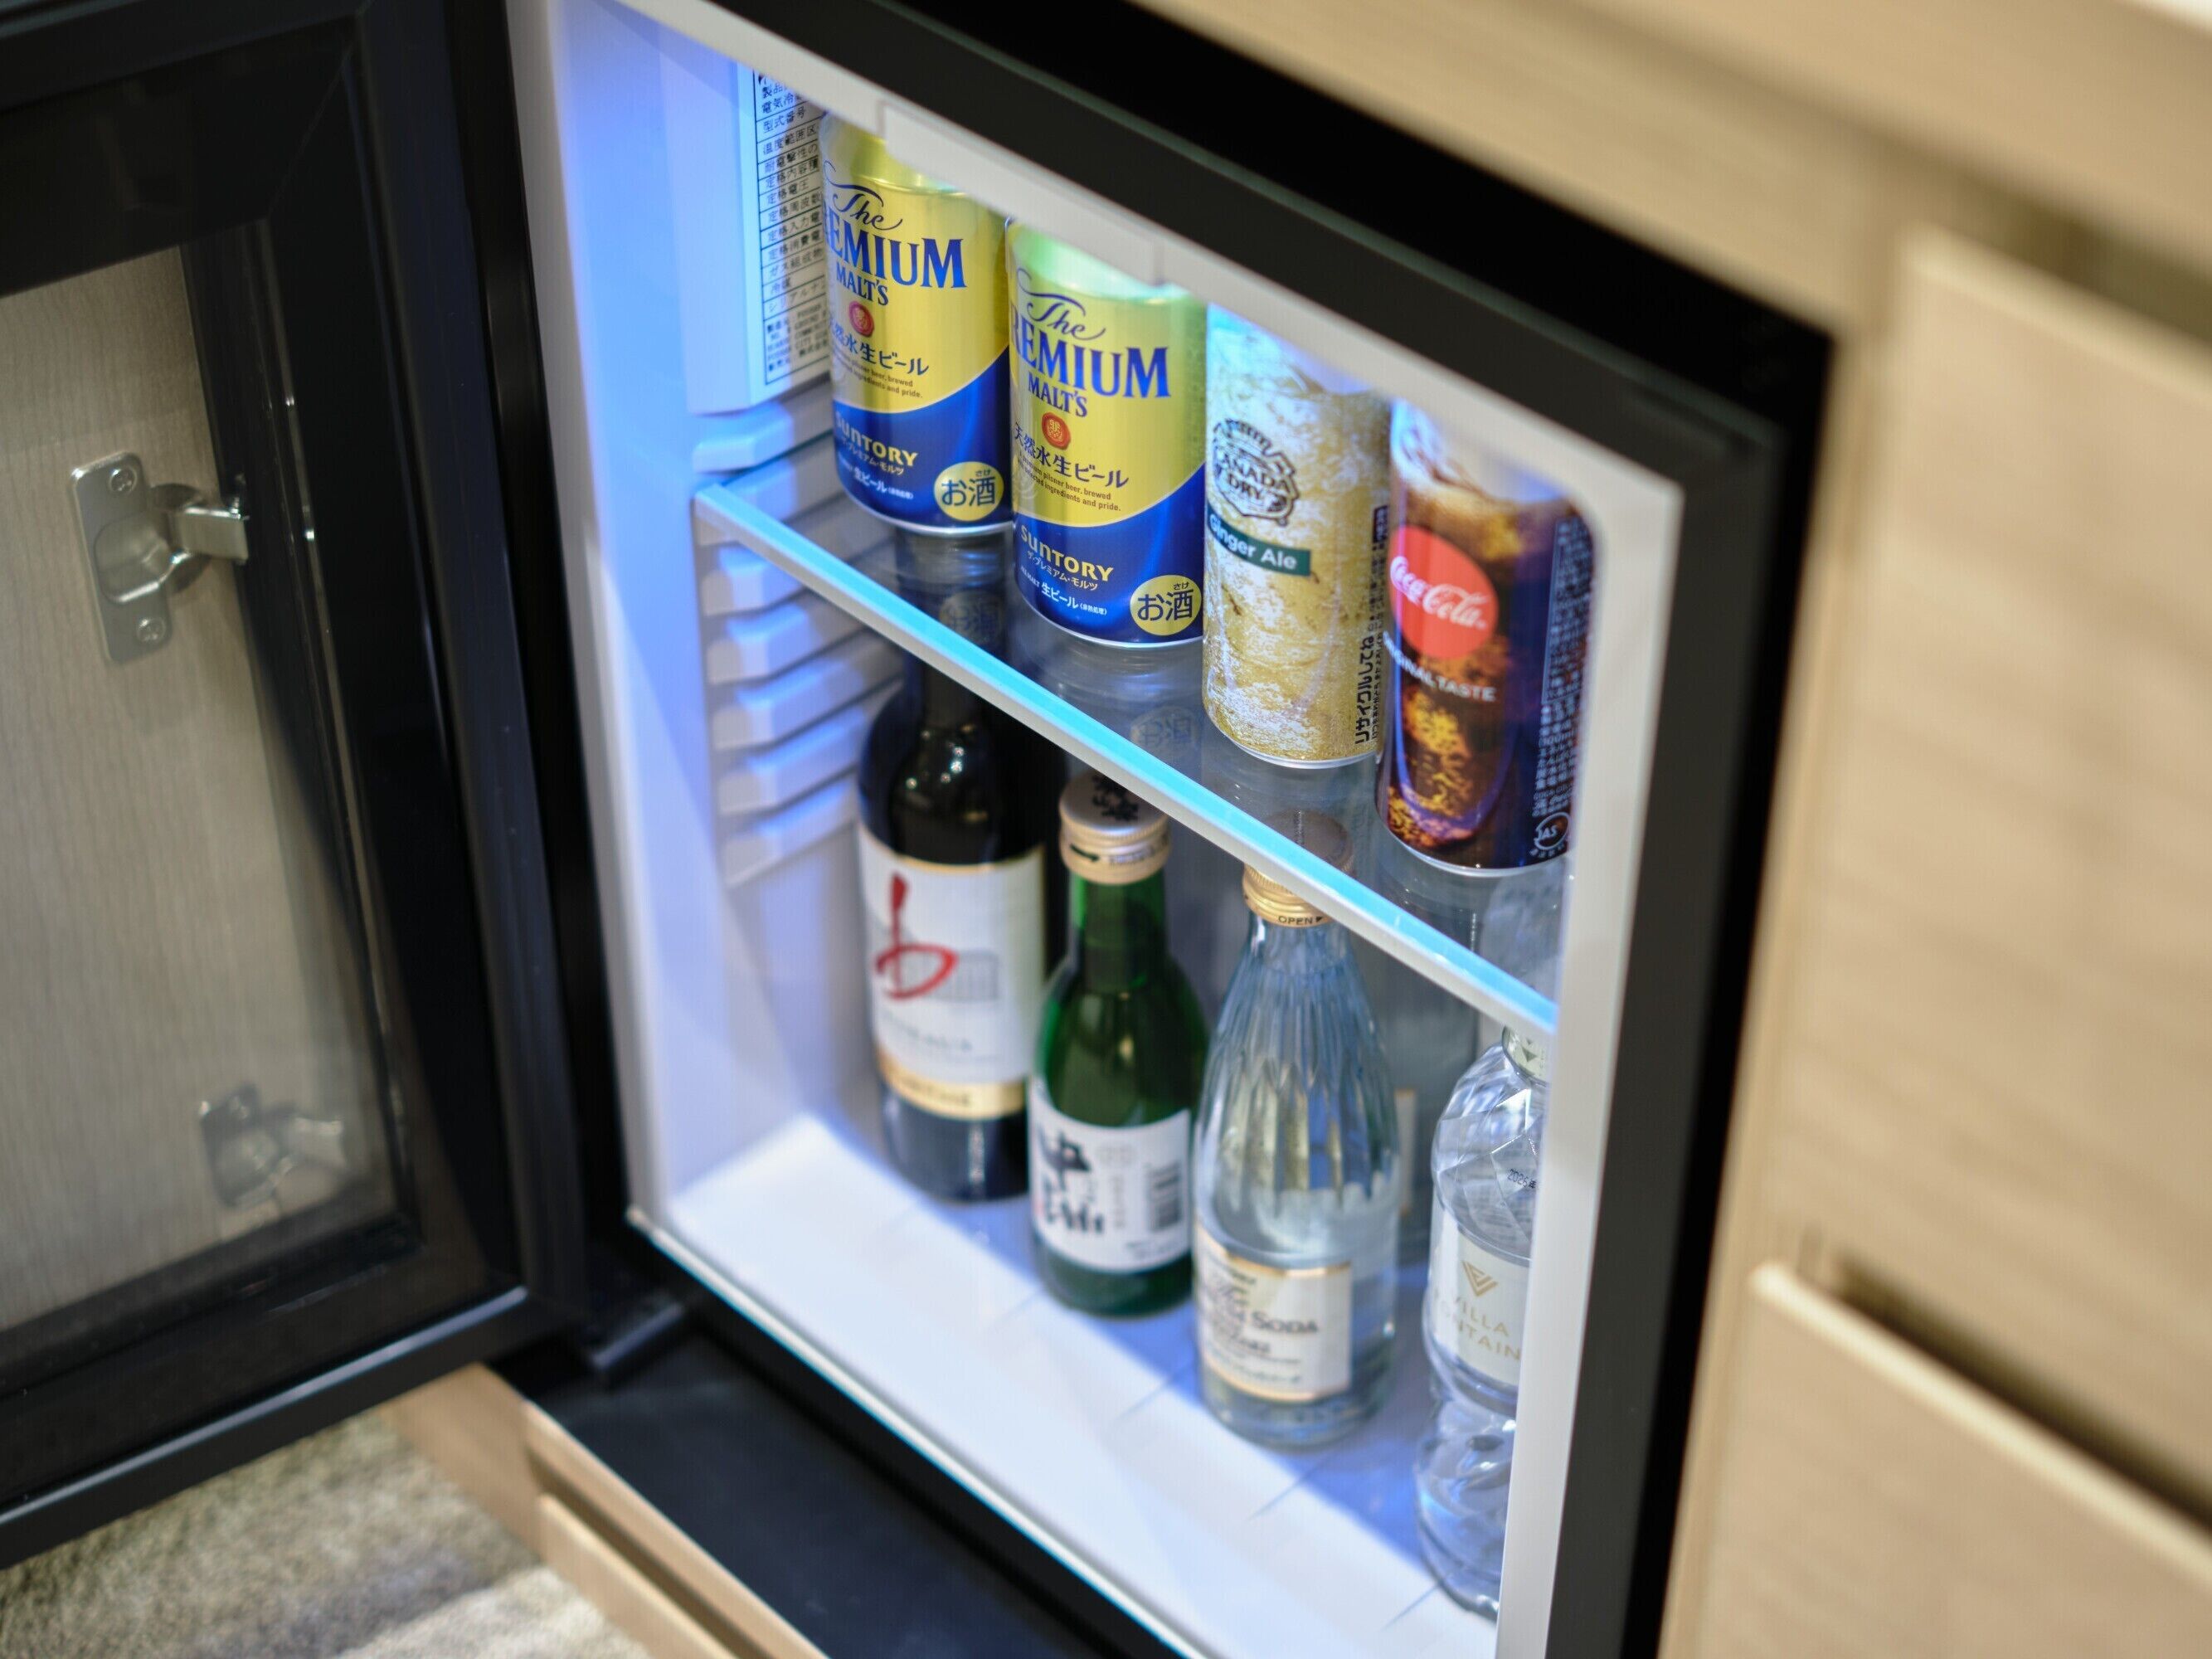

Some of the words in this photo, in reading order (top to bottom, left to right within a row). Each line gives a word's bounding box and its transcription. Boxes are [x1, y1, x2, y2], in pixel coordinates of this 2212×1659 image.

[762, 83, 787, 99] 製品
[762, 92, 801, 114] 電気冷
[824, 160, 903, 231] The
[824, 200, 968, 289] EMIUM
[837, 261, 889, 306] MALT'S
[1017, 267, 1106, 341] The
[830, 316, 930, 376] 然水生ビール
[1011, 302, 1171, 398] REMIUM
[1028, 371, 1088, 418] MALT'S
[1015, 421, 1130, 489] 天然水生ビール
[941, 476, 997, 507] お酒
[1082, 498, 1096, 507] and
[1098, 501, 1121, 512] pride.
[1083, 488, 1111, 500] brewed
[1228, 473, 1261, 500] DRY
[1020, 524, 1114, 582] SUNTORY
[1210, 513, 1257, 558] Ginger
[1261, 547, 1298, 570] Ale
[1041, 581, 1080, 610] 生ビール
[1137, 588, 1194, 621] お酒
[1173, 582, 1189, 591] さけ
[1355, 635, 1373, 744] リサイクルしてね
[1436, 675, 1498, 703] TASTE
[1277, 915, 1313, 925] OPEN
